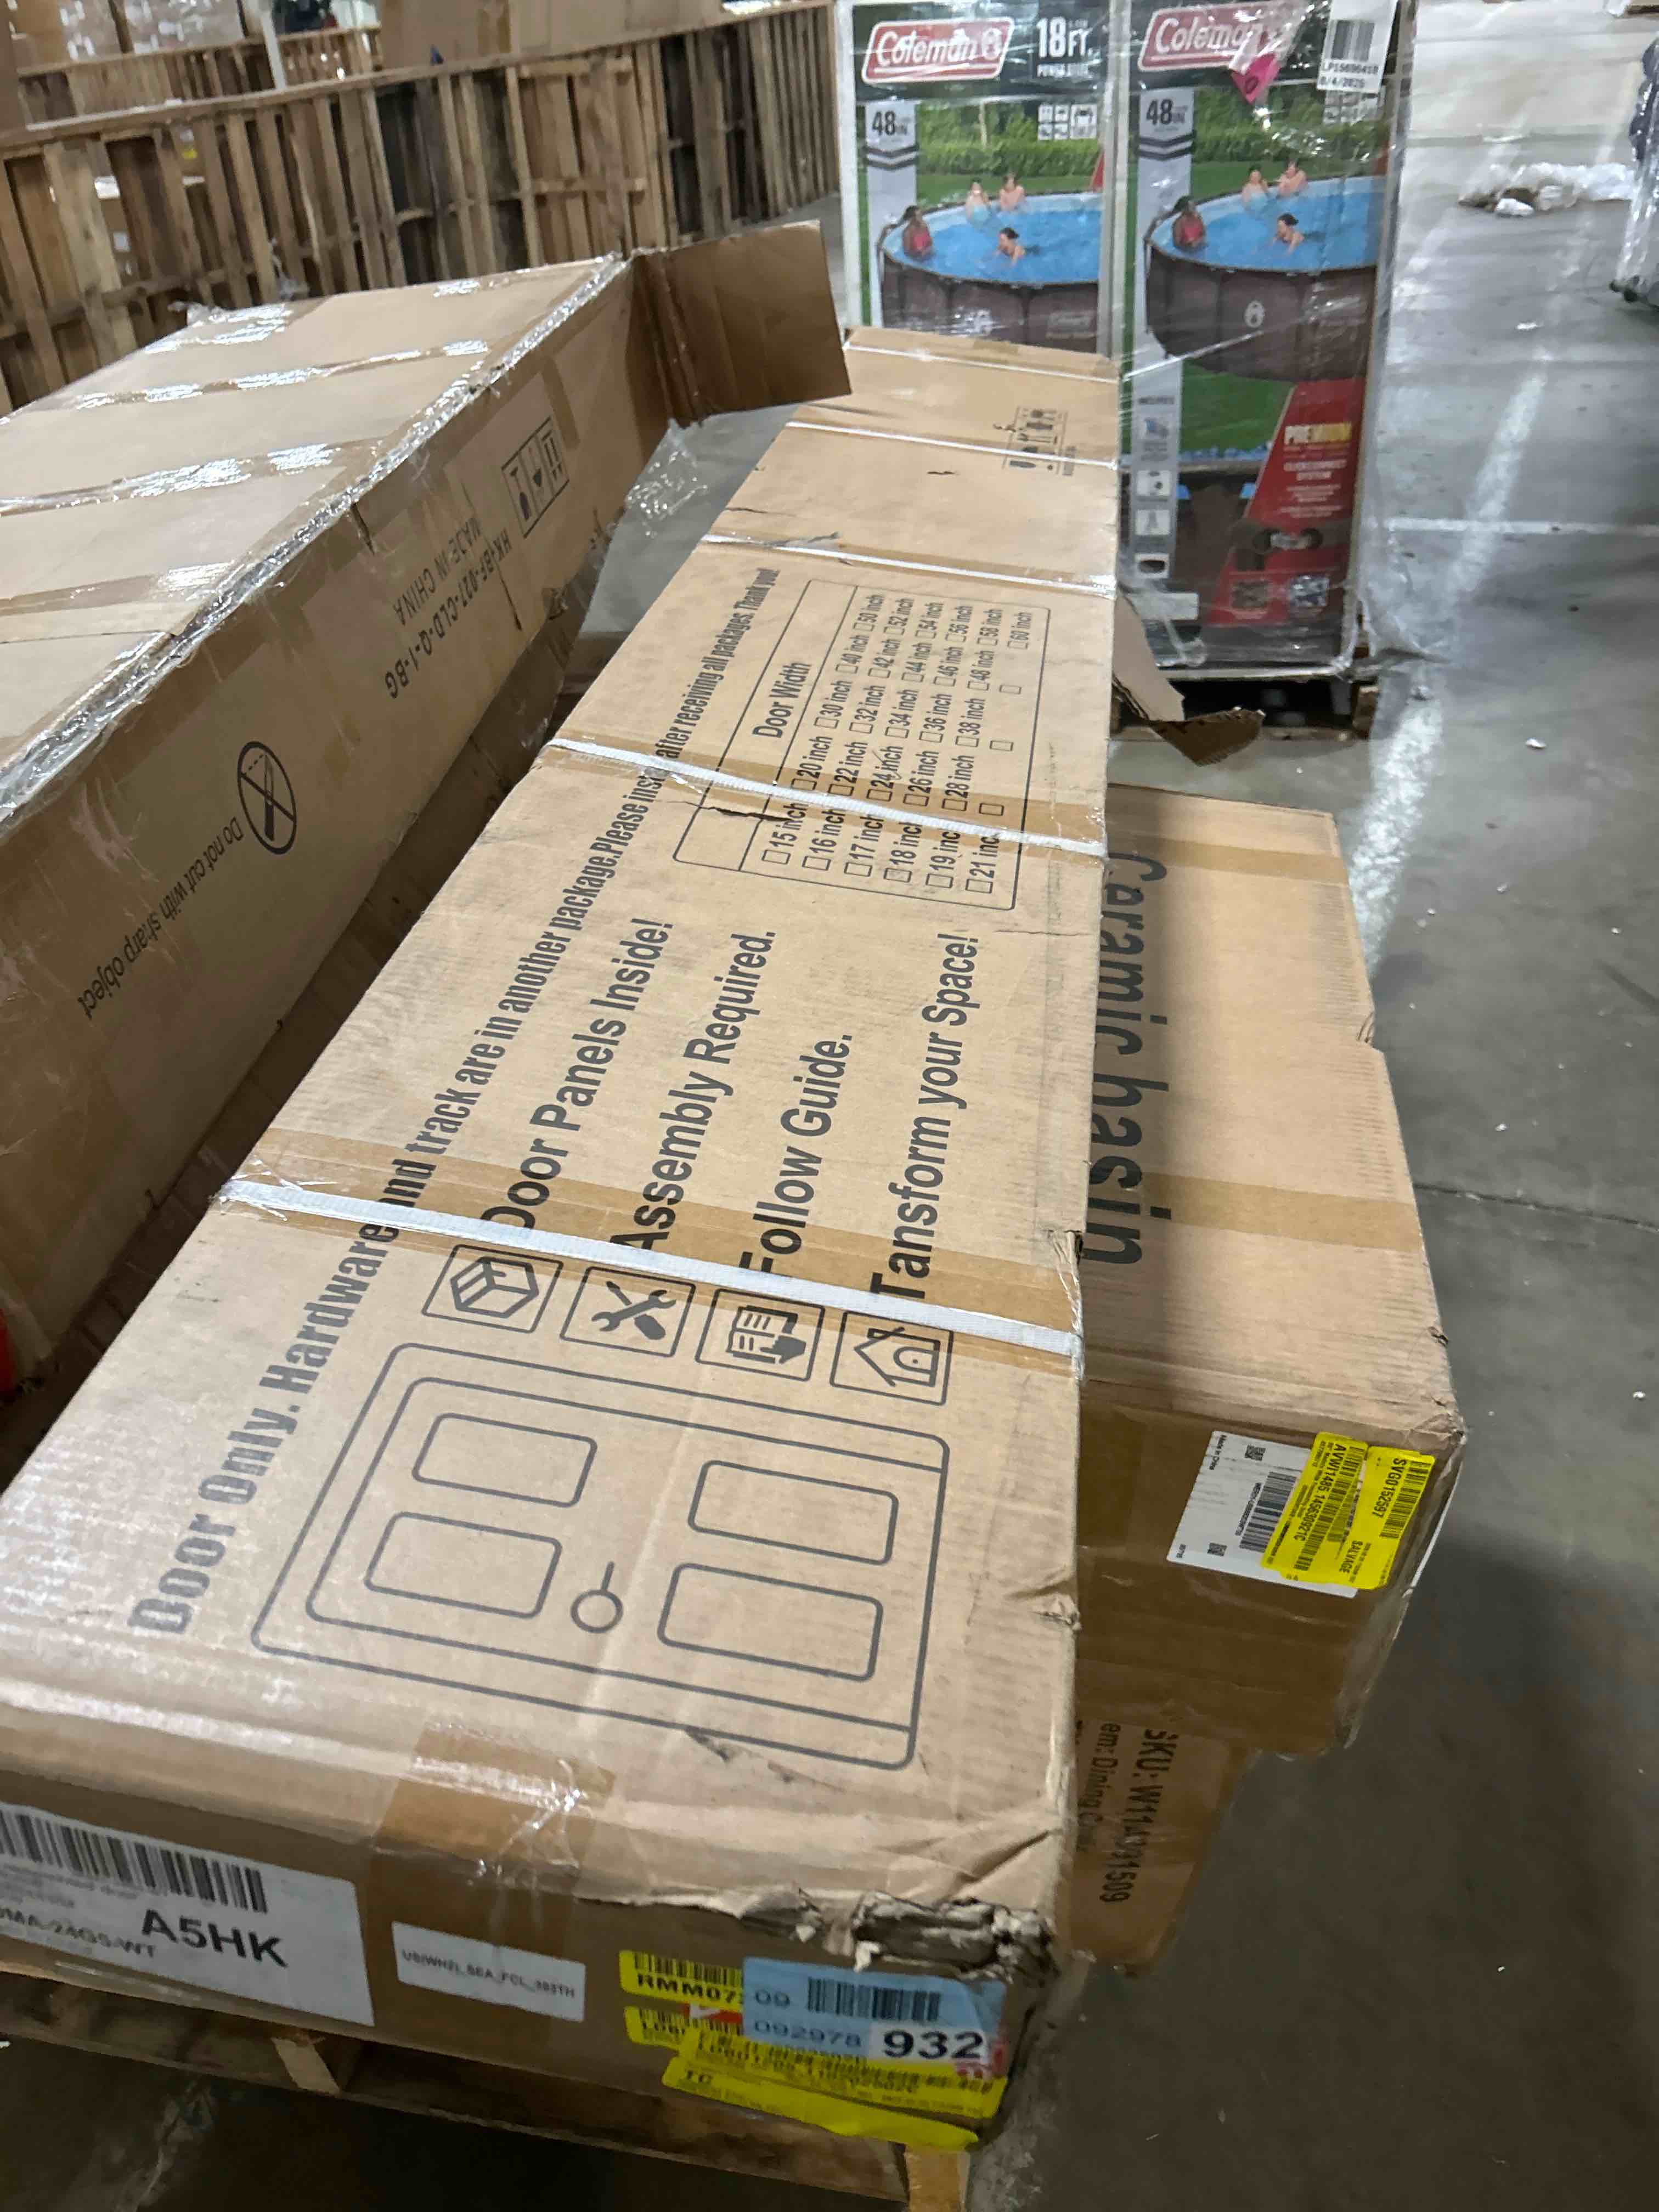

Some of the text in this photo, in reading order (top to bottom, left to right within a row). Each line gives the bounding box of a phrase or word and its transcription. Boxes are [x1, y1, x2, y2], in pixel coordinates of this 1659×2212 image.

[877, 28, 977, 66] Coleman
[1155, 18, 1262, 54] Colema
[872, 111, 896, 136] 48
[1146, 99, 1172, 125] 48
[392, 568, 436, 625] CHINA
[733, 583, 772, 612] Thank
[861, 594, 885, 612] inch
[891, 597, 915, 616] inch
[920, 602, 944, 622] inch
[950, 605, 973, 624] inch
[981, 608, 1003, 627] inch
[1011, 612, 1034, 630] inch
[710, 611, 754, 658] packages.
[849, 634, 870, 653] inch
[876, 638, 901, 657] inch
[908, 642, 933, 662] inch
[941, 646, 964, 664] inch
[972, 650, 995, 669] inch
[701, 655, 729, 672] all
[680, 669, 724, 728] receiving
[752, 662, 812, 739] Door Width
[825, 680, 851, 703] inch
[860, 685, 886, 707] inch
[892, 689, 919, 712] inch
[820, 703, 843, 718] 30
[855, 708, 878, 723] 32
[927, 693, 953, 716] inch
[961, 698, 986, 721] inch
[889, 713, 912, 727] 34
[923, 717, 947, 731] 36
[958, 722, 981, 736] 38
[656, 724, 692, 759] after
[803, 736, 833, 761] inch
[839, 741, 868, 766] inch
[875, 745, 904, 771] inch
[911, 750, 939, 777] inch
[947, 754, 975, 782] inch
[797, 763, 823, 779] 20
[834, 766, 860, 783] 22
[871, 772, 895, 789] 24
[907, 777, 932, 794] 26
[945, 782, 969, 799] 28
[777, 802, 809, 831] inch
[769, 830, 798, 848] 15
[809, 836, 837, 855] 16
[933, 831, 961, 853] inc
[849, 843, 876, 861] 17
[890, 849, 917, 866] 18
[929, 854, 956, 871] 19
[969, 835, 1000, 878] 21 inc
[77, 817, 245, 1020] Do not cut with sharp object
[499, 932, 571, 1014] another
[921, 933, 980, 1026] Space!
[475, 1015, 523, 1040] in
[455, 1043, 506, 1087] are
[479, 918, 674, 1229] Door Panels Inside!
[918, 1031, 967, 1110] your
[610, 931, 776, 1251] Assembly Required.
[404, 1088, 481, 1155] track
[738, 1034, 853, 1276] Follow Guide.
[1083, 1073, 1172, 1264] basin
[259, 1219, 400, 1395] Hardware
[1339, 1540, 1363, 1574] SALVAGE
[127, 1513, 237, 1634] Door
[1132, 1728, 1179, 1779] SKU:
[141, 1908, 288, 1968] A5HK
[637, 1973, 742, 2004] RMM07
[883, 2029, 984, 2059] 932
